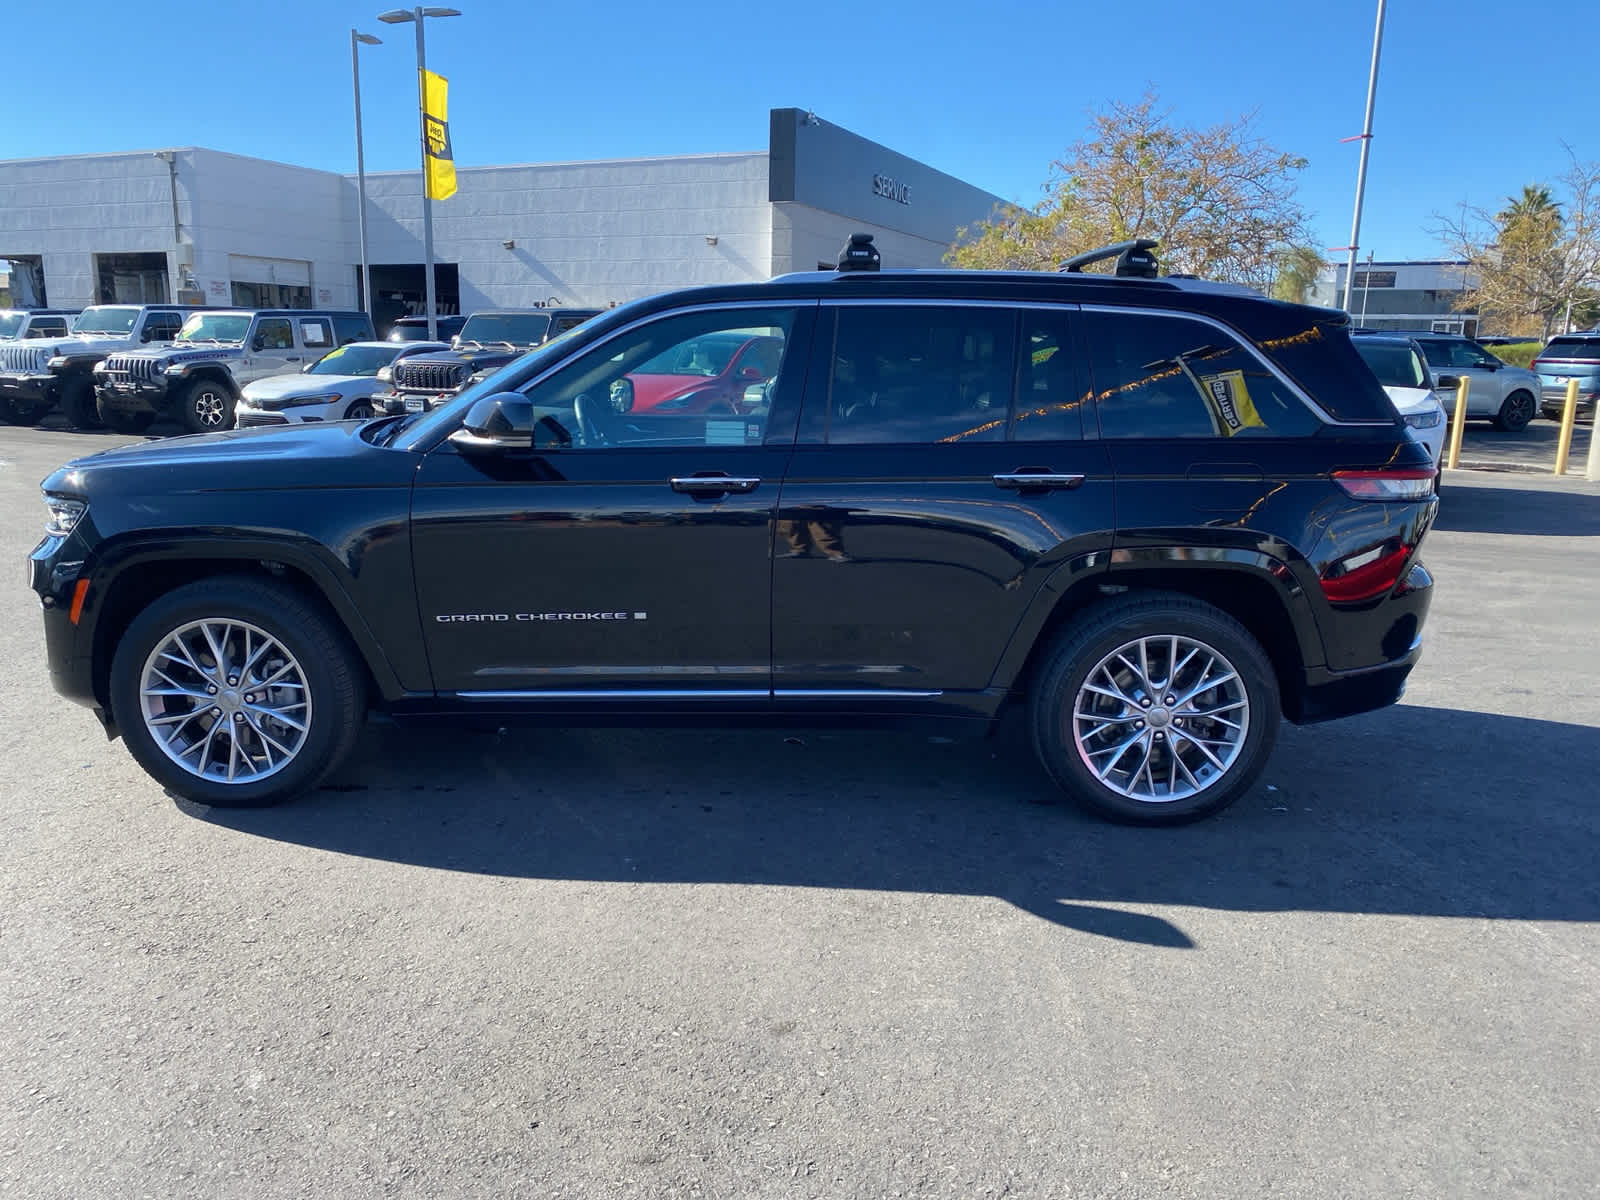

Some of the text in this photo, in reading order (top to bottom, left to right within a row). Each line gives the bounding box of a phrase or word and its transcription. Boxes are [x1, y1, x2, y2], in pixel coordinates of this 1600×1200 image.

[1212, 381, 1239, 428] CERTIFIED
[436, 612, 628, 622] GRAND CHEROKEE
